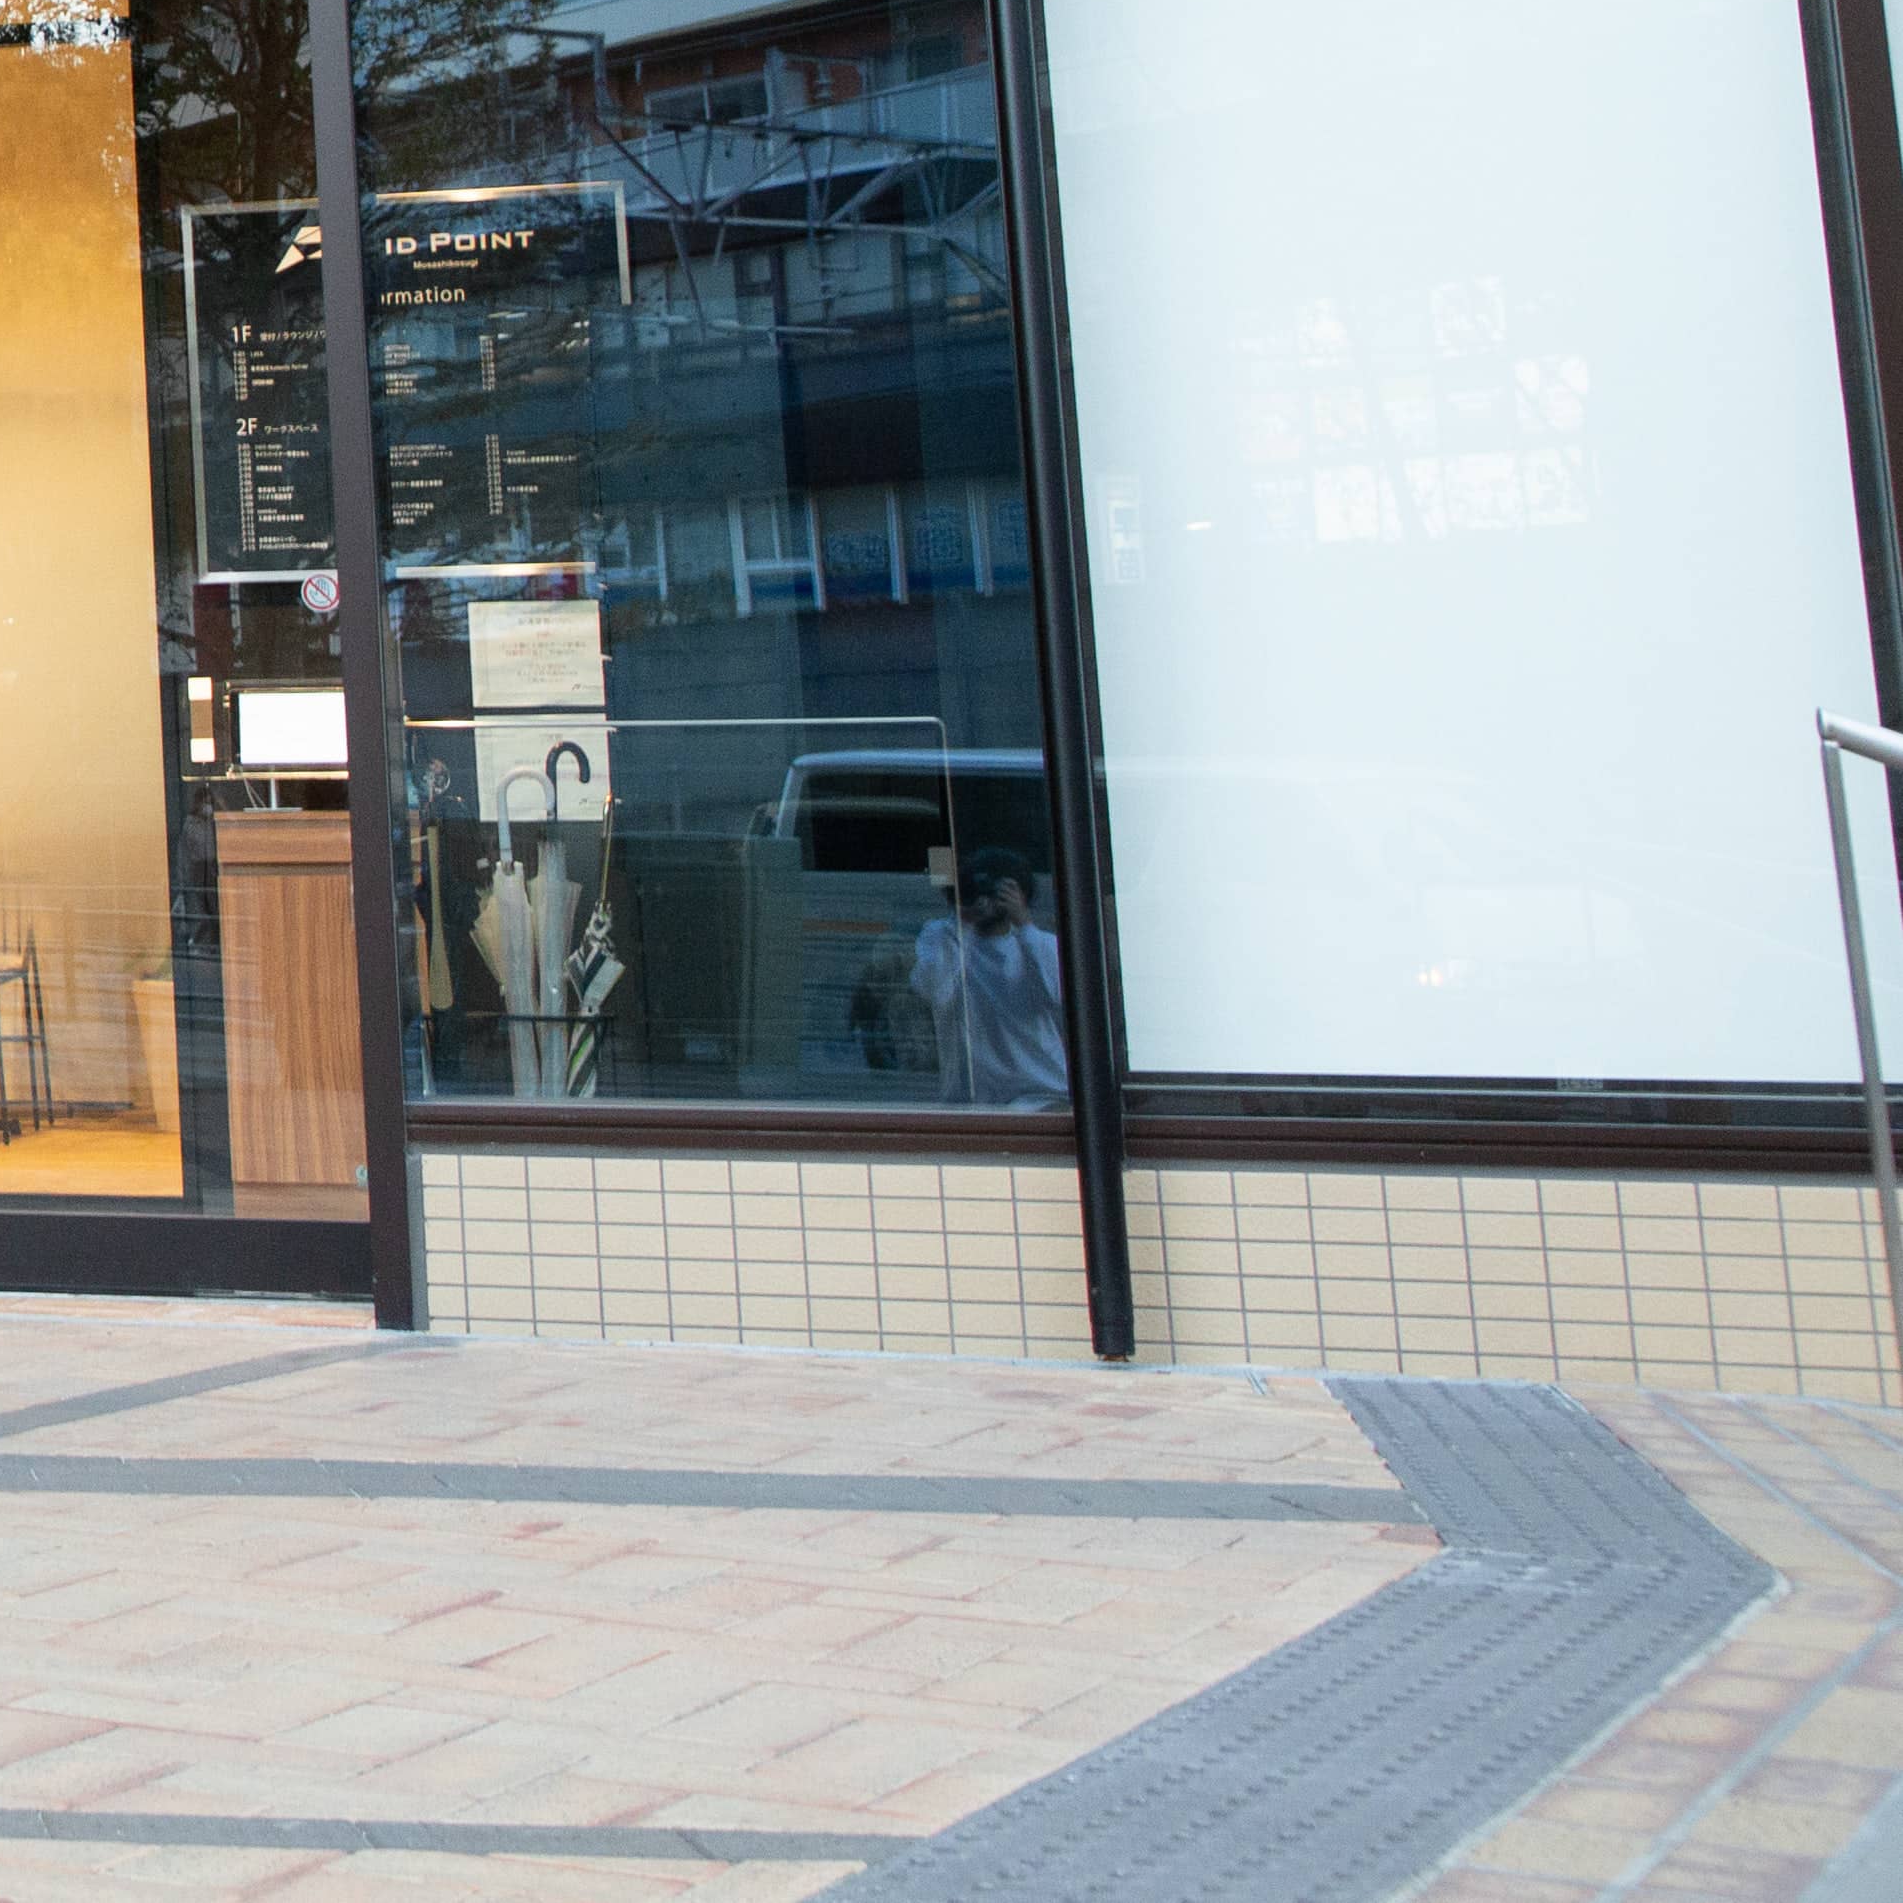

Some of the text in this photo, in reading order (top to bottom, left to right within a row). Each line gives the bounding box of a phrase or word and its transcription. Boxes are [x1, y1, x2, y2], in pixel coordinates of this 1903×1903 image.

[385, 229, 535, 255] ID POINT
[231, 324, 252, 343] 1F
[236, 417, 258, 436] 2F
